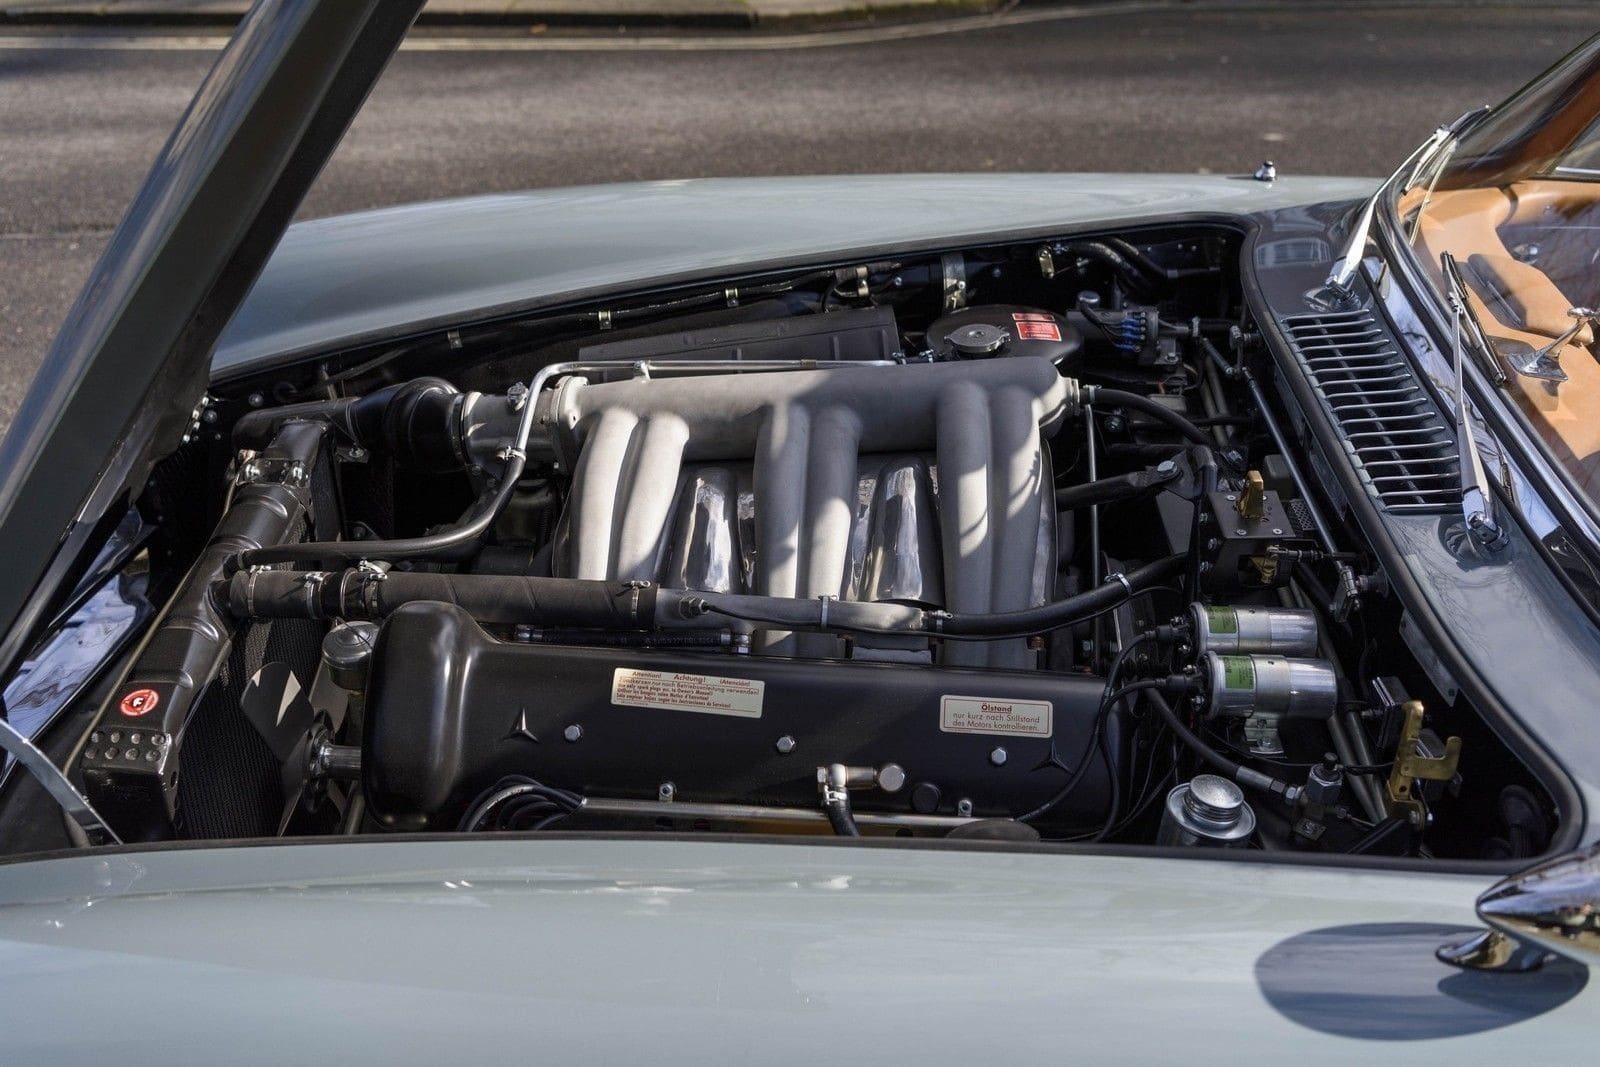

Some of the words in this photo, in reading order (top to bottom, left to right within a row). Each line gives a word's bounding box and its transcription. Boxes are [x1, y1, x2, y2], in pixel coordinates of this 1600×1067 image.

[674, 675, 706, 684] Achtung!
[133, 697, 144, 707] F
[981, 703, 1013, 712] Ölstand
[967, 712, 982, 720] kurz
[986, 714, 1004, 722] nach
[1006, 714, 1040, 723] Stillstand
[967, 720, 992, 728] Motors
[994, 722, 1039, 731] kontrollieren.
